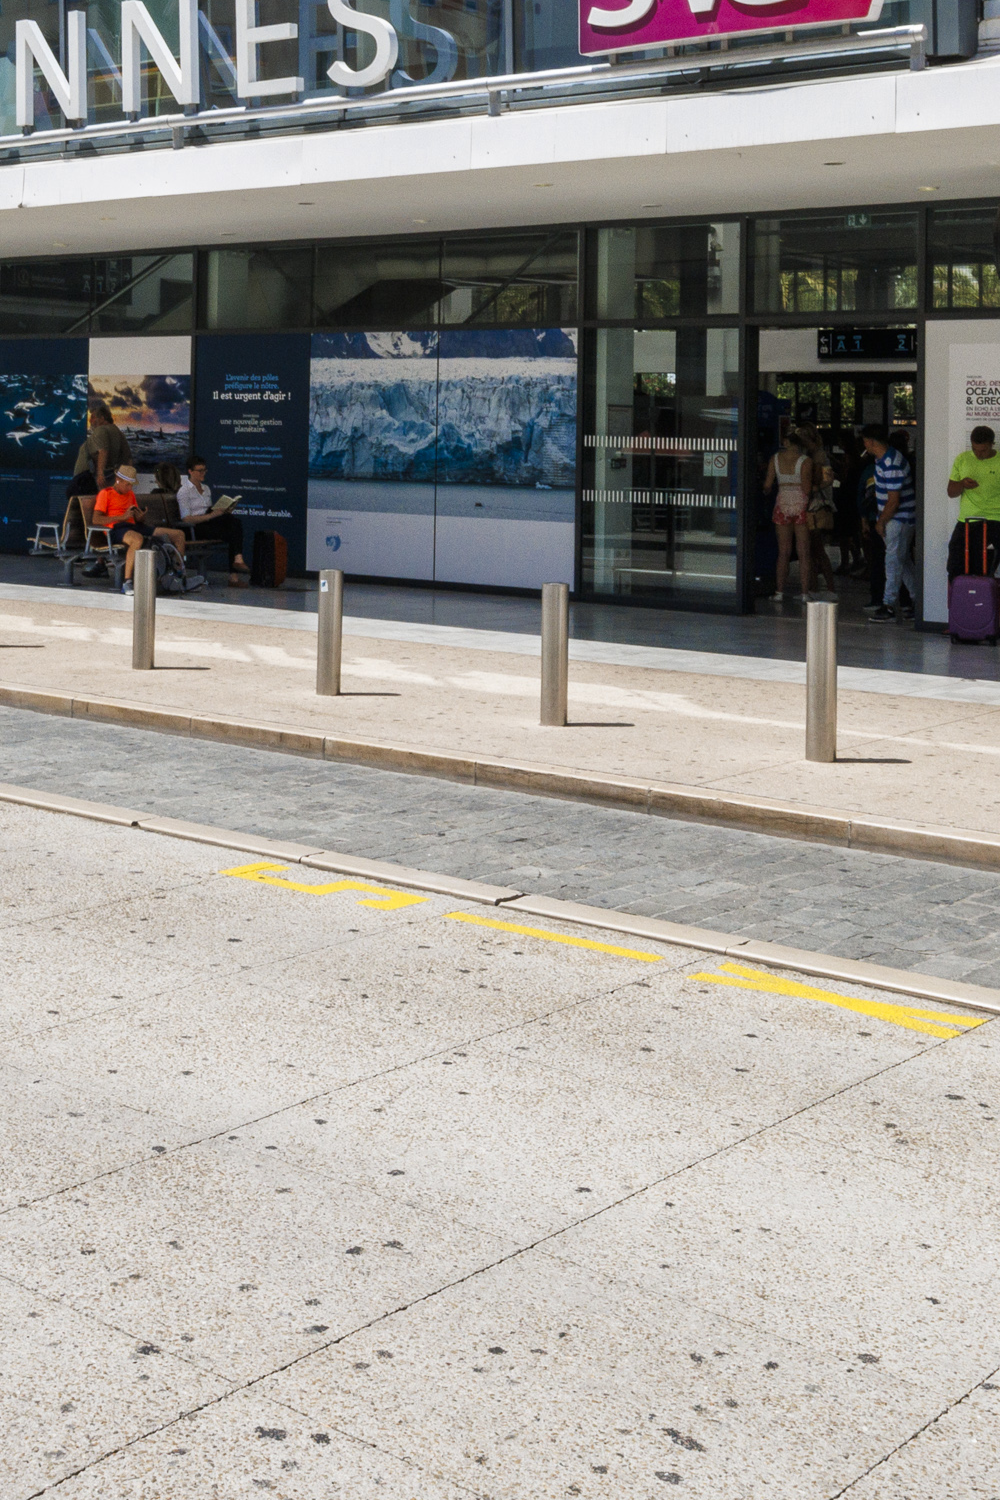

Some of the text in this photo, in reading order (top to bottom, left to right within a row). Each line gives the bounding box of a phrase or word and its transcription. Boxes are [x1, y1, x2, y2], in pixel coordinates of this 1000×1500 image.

[837, 340, 905, 350] A 1 2
[250, 373, 261, 381] des
[213, 390, 219, 400] Il
[220, 392, 232, 400] est
[234, 392, 261, 403] urgent
[263, 391, 286, 403] d'agir
[966, 396, 973, 405] &
[233, 418, 258, 426] nouvelle
[259, 419, 283, 427] gestion
